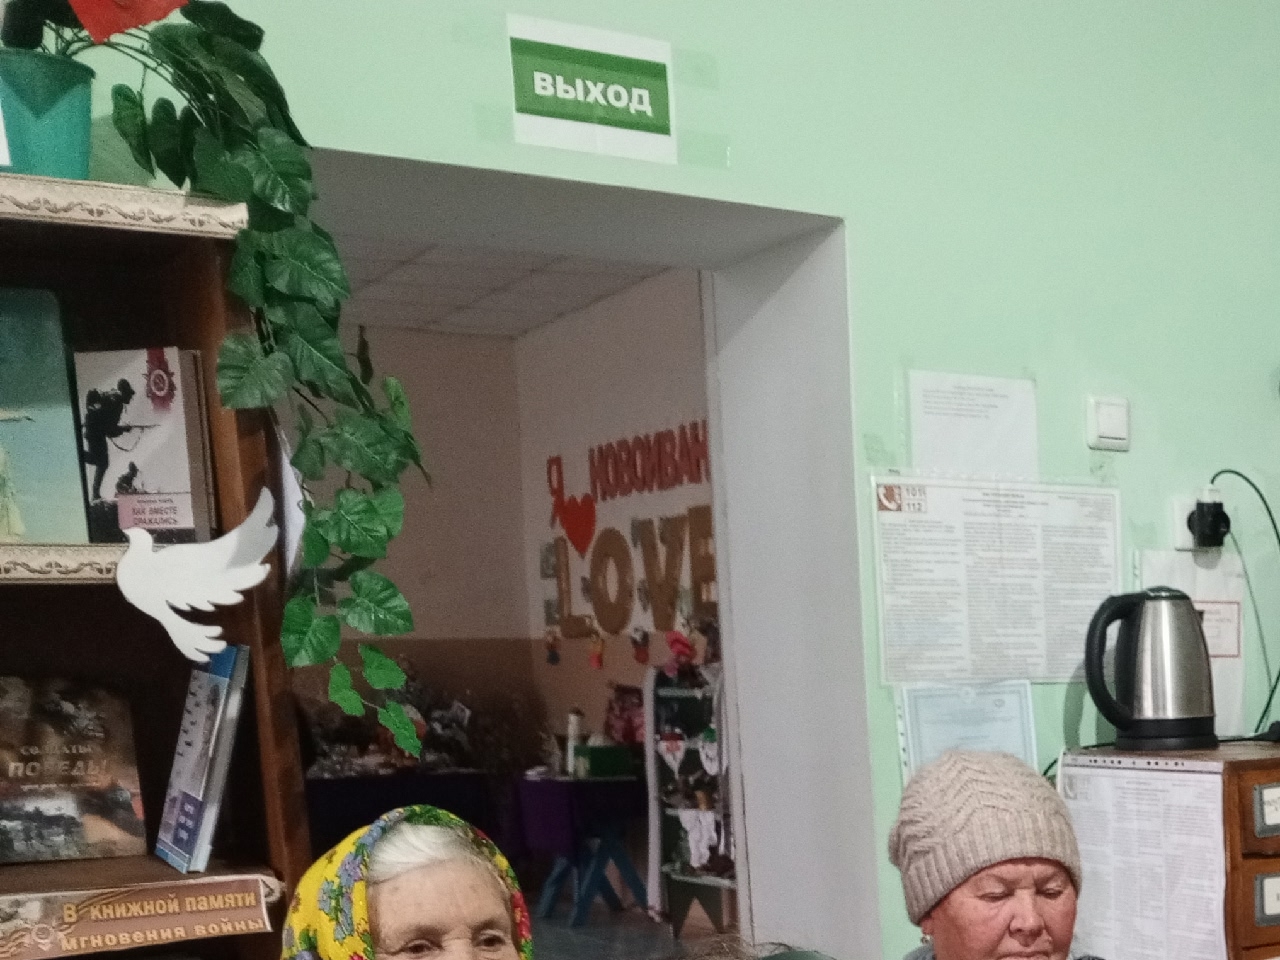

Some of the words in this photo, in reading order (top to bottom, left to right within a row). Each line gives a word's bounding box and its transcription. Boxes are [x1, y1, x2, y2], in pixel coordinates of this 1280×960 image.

[533, 71, 653, 117] ВЫХОД
[906, 502, 922, 512] 112
[553, 505, 717, 638] LOVE
[63, 904, 78, 923] В
[90, 893, 181, 921] книжной
[185, 891, 257, 912] памяти
[194, 917, 265, 937] войны
